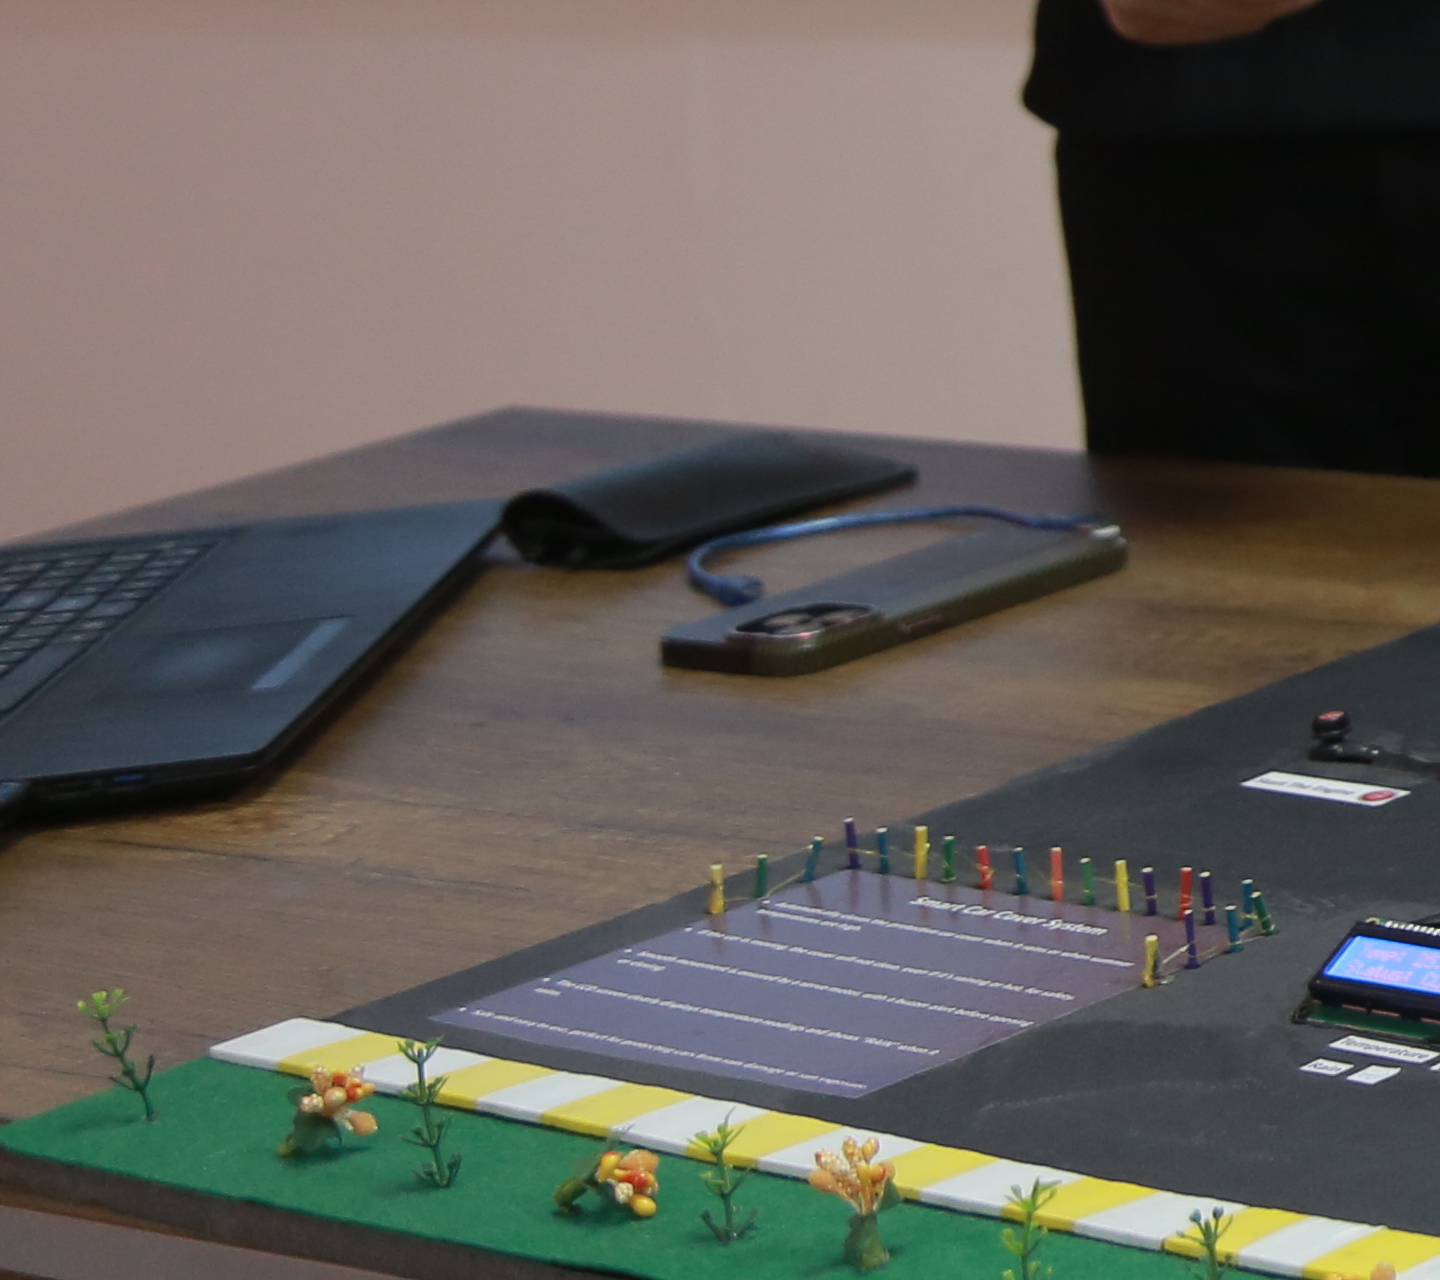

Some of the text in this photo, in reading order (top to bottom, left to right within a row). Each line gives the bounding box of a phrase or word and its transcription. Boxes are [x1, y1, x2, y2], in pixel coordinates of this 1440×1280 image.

[908, 897, 1108, 936] Smart Car Cover System
[1341, 1038, 1430, 1059] Temperature
